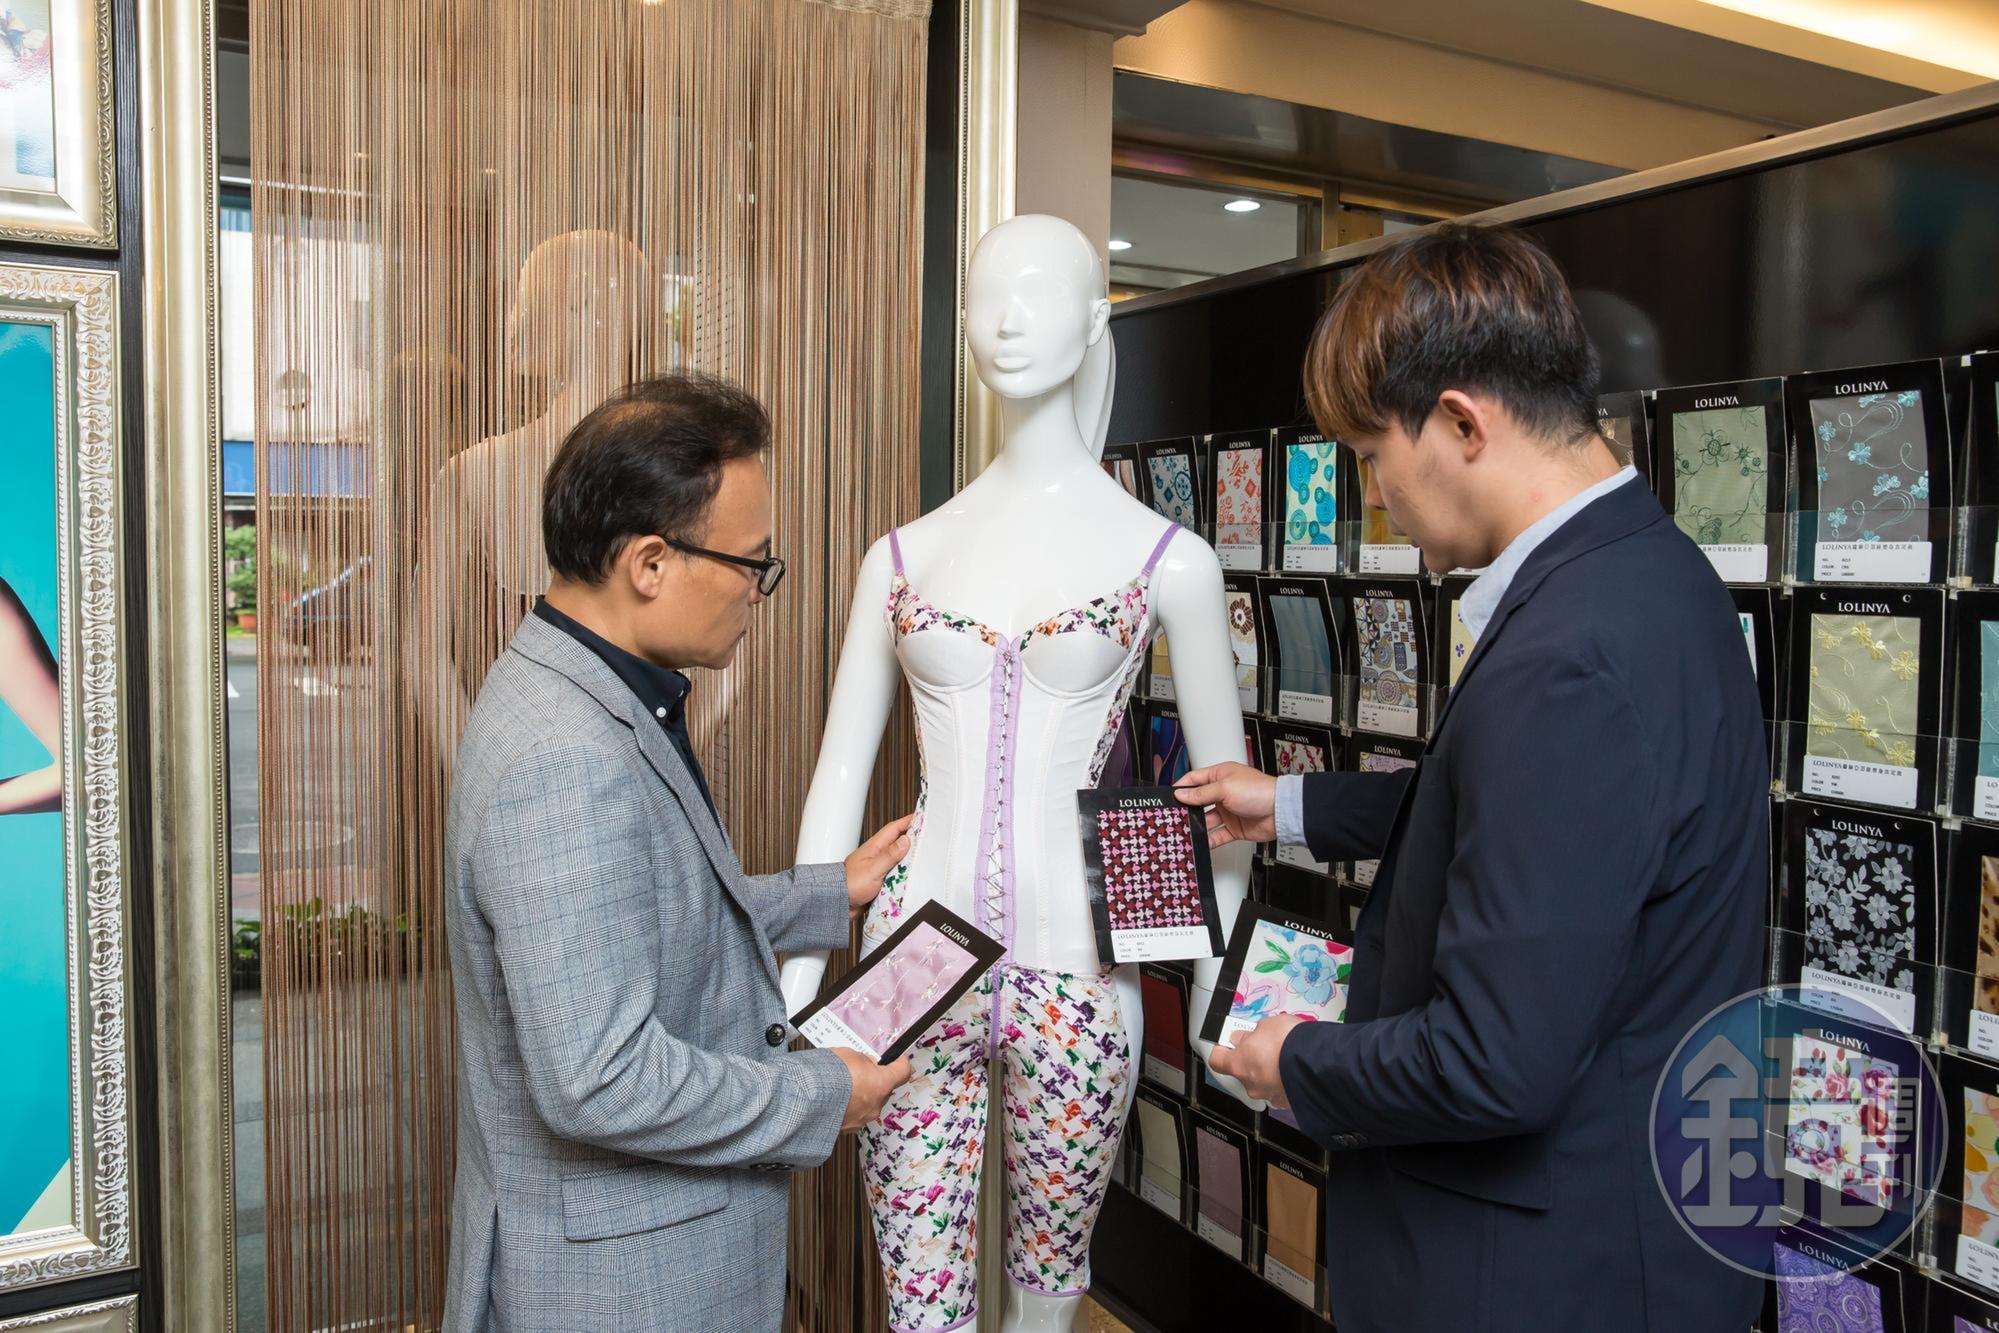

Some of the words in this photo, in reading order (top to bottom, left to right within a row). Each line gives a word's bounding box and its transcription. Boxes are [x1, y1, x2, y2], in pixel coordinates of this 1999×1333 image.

[1835, 381, 1889, 395] LOLINYA
[1695, 396, 1739, 409] LOLINYA
[1229, 441, 1251, 449] LOLINYA
[1298, 435, 1323, 443] LOLINYA
[1156, 447, 1177, 456] LOLINYA
[1280, 587, 1304, 595] LOLINYA
[1366, 589, 1394, 598] LOLINYA
[1838, 602, 1890, 614] LOLINYA
[1285, 733, 1309, 744] LOLINYA
[1374, 745, 1401, 756] LOLINYA
[1119, 798, 1164, 808] LOLINYA
[1831, 820, 1884, 837] LOLINYA
[939, 923, 970, 947] LOLINYA
[1284, 920, 1334, 940] LOLINYA
[1820, 1028, 1870, 1052] LOLINYA
[1279, 1161, 1304, 1179] LOLINYA
[1799, 1242, 1850, 1272] LOLINYA
